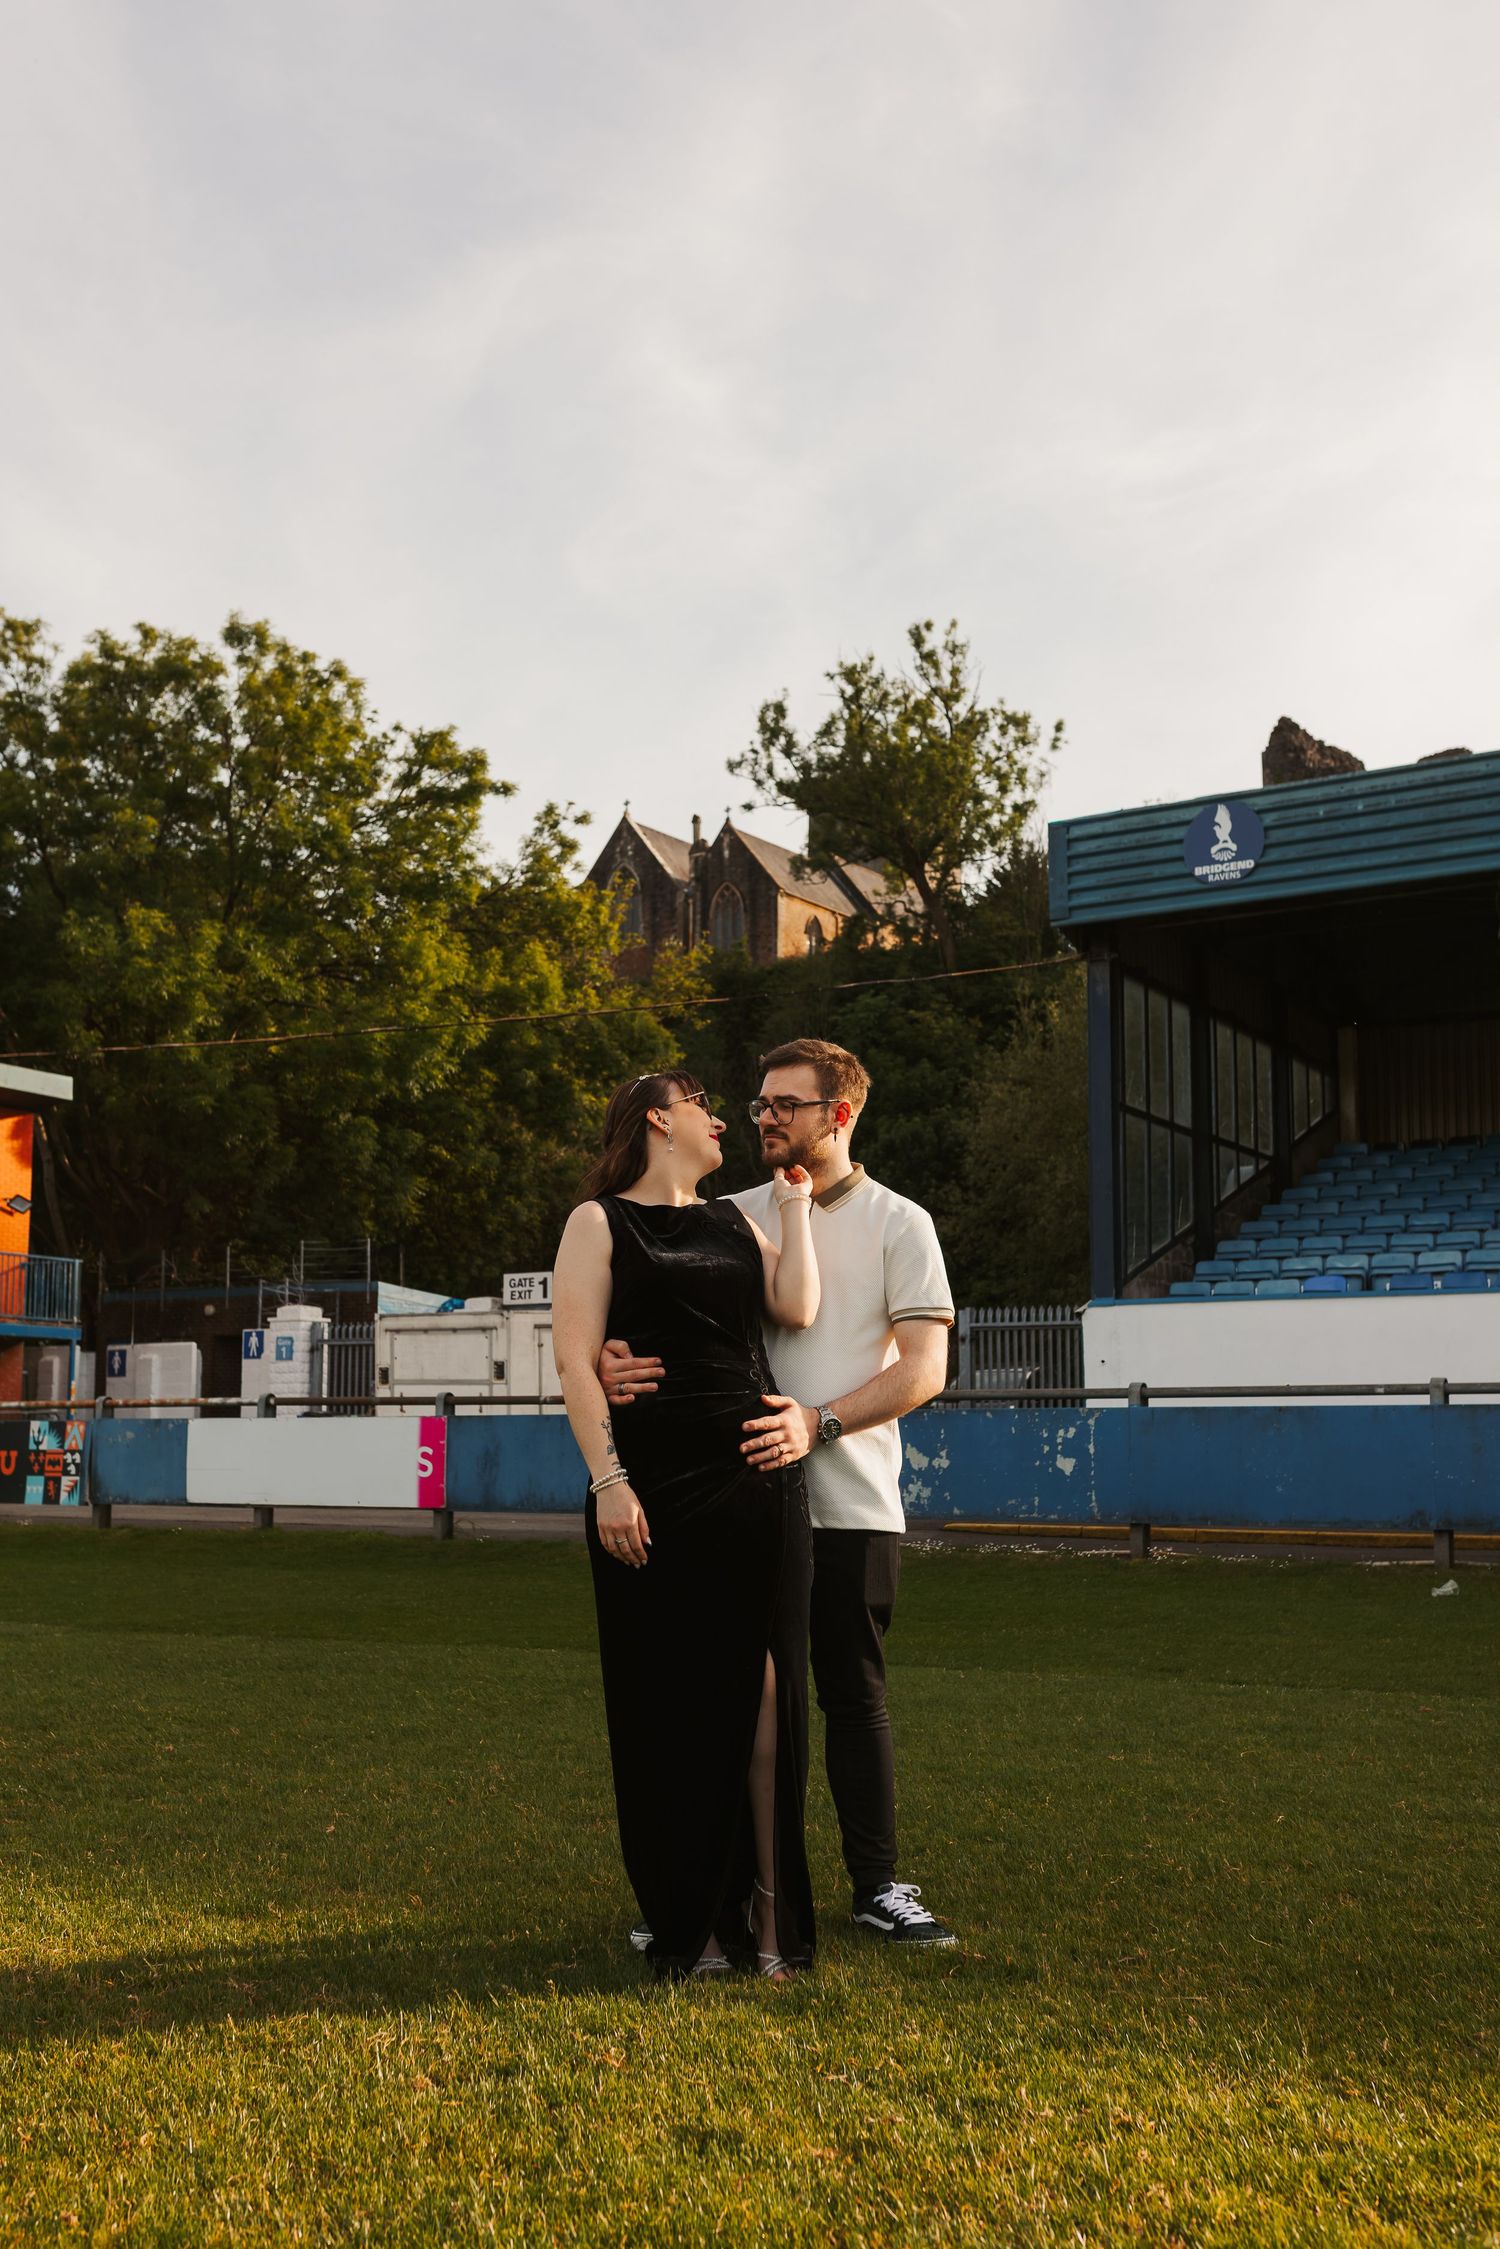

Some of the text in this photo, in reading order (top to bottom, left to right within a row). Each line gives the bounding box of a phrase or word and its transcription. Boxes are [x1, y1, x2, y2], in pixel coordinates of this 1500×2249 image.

[1194, 859, 1254, 876] BRIDGEND
[1208, 870, 1241, 883] RAVENS
[509, 1277, 535, 1289] GATE
[538, 1276, 548, 1299] 1
[510, 1289, 532, 1300] EXIT
[280, 1346, 287, 1359] 1
[417, 1446, 434, 1477] S
